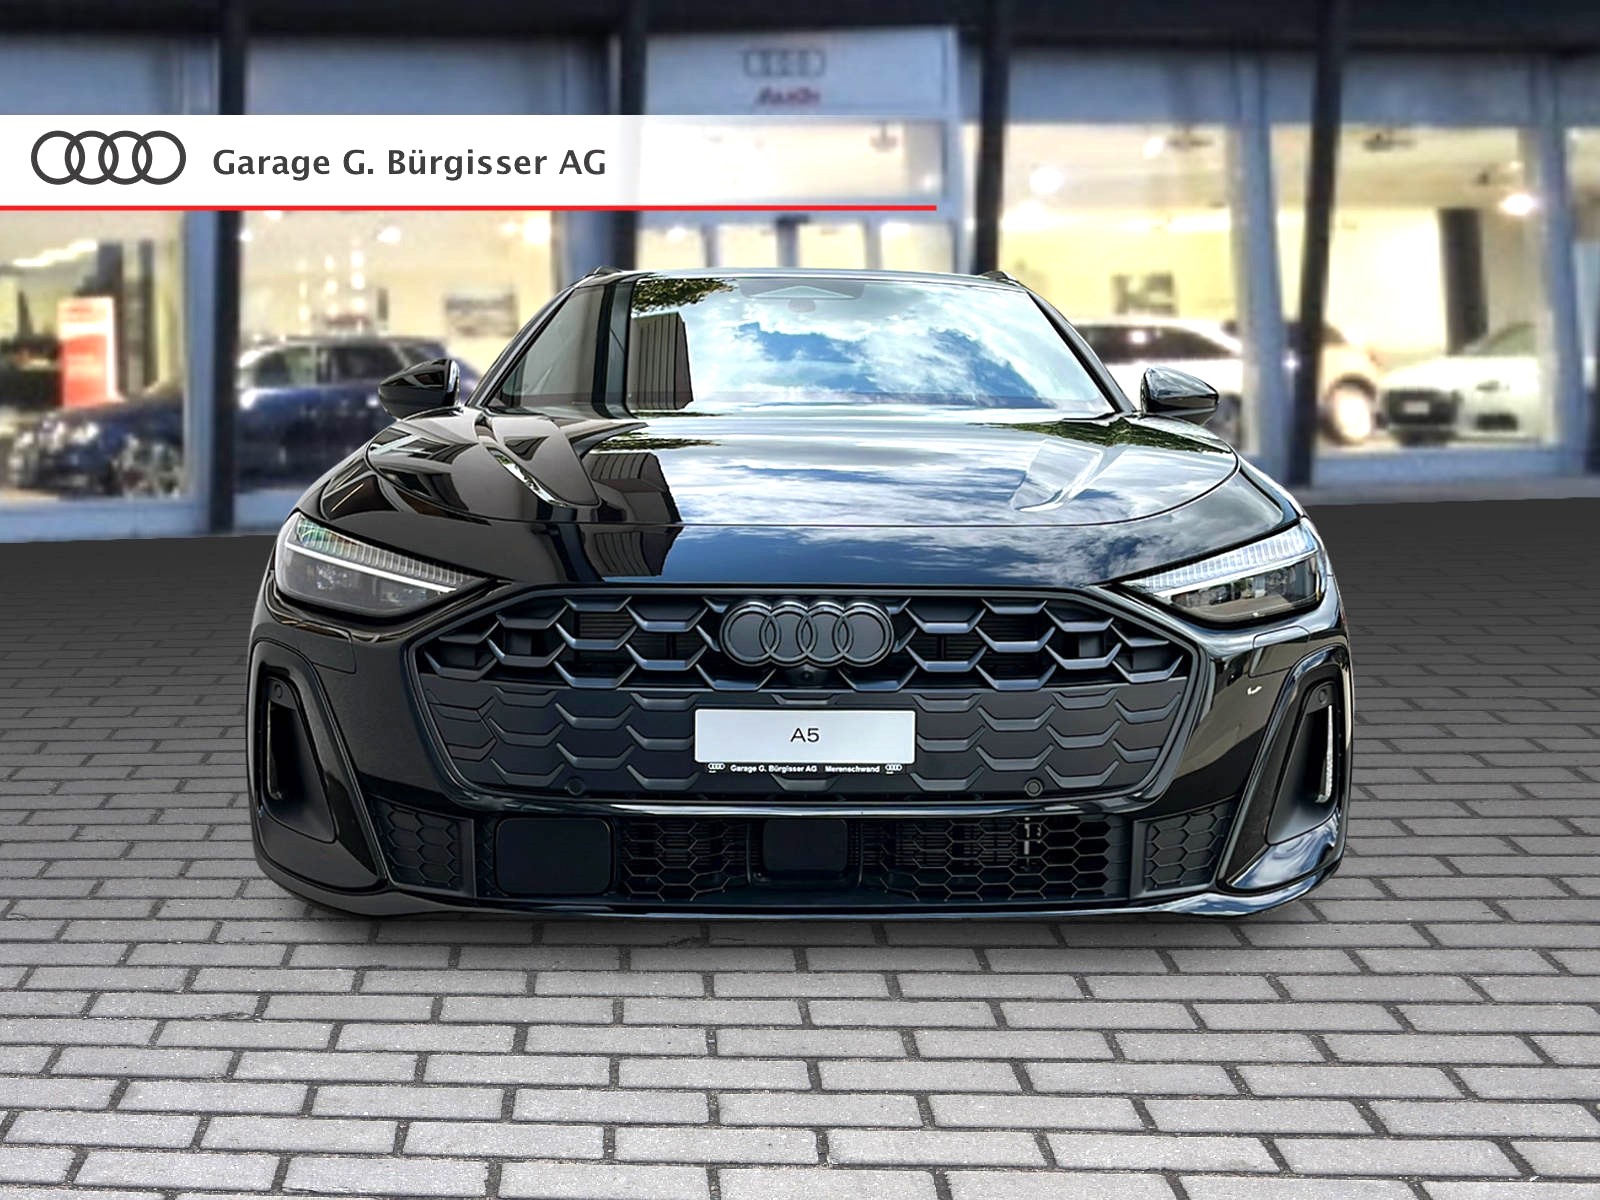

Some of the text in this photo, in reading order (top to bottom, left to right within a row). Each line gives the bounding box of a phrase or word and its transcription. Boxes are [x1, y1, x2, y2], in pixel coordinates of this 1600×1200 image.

[790, 727, 820, 743] A5
[730, 764, 758, 774] Garage
[758, 764, 768, 773] G.
[768, 764, 804, 774] Bürgisser
[804, 764, 818, 773] AG
[824, 765, 881, 773] Merenschwand
